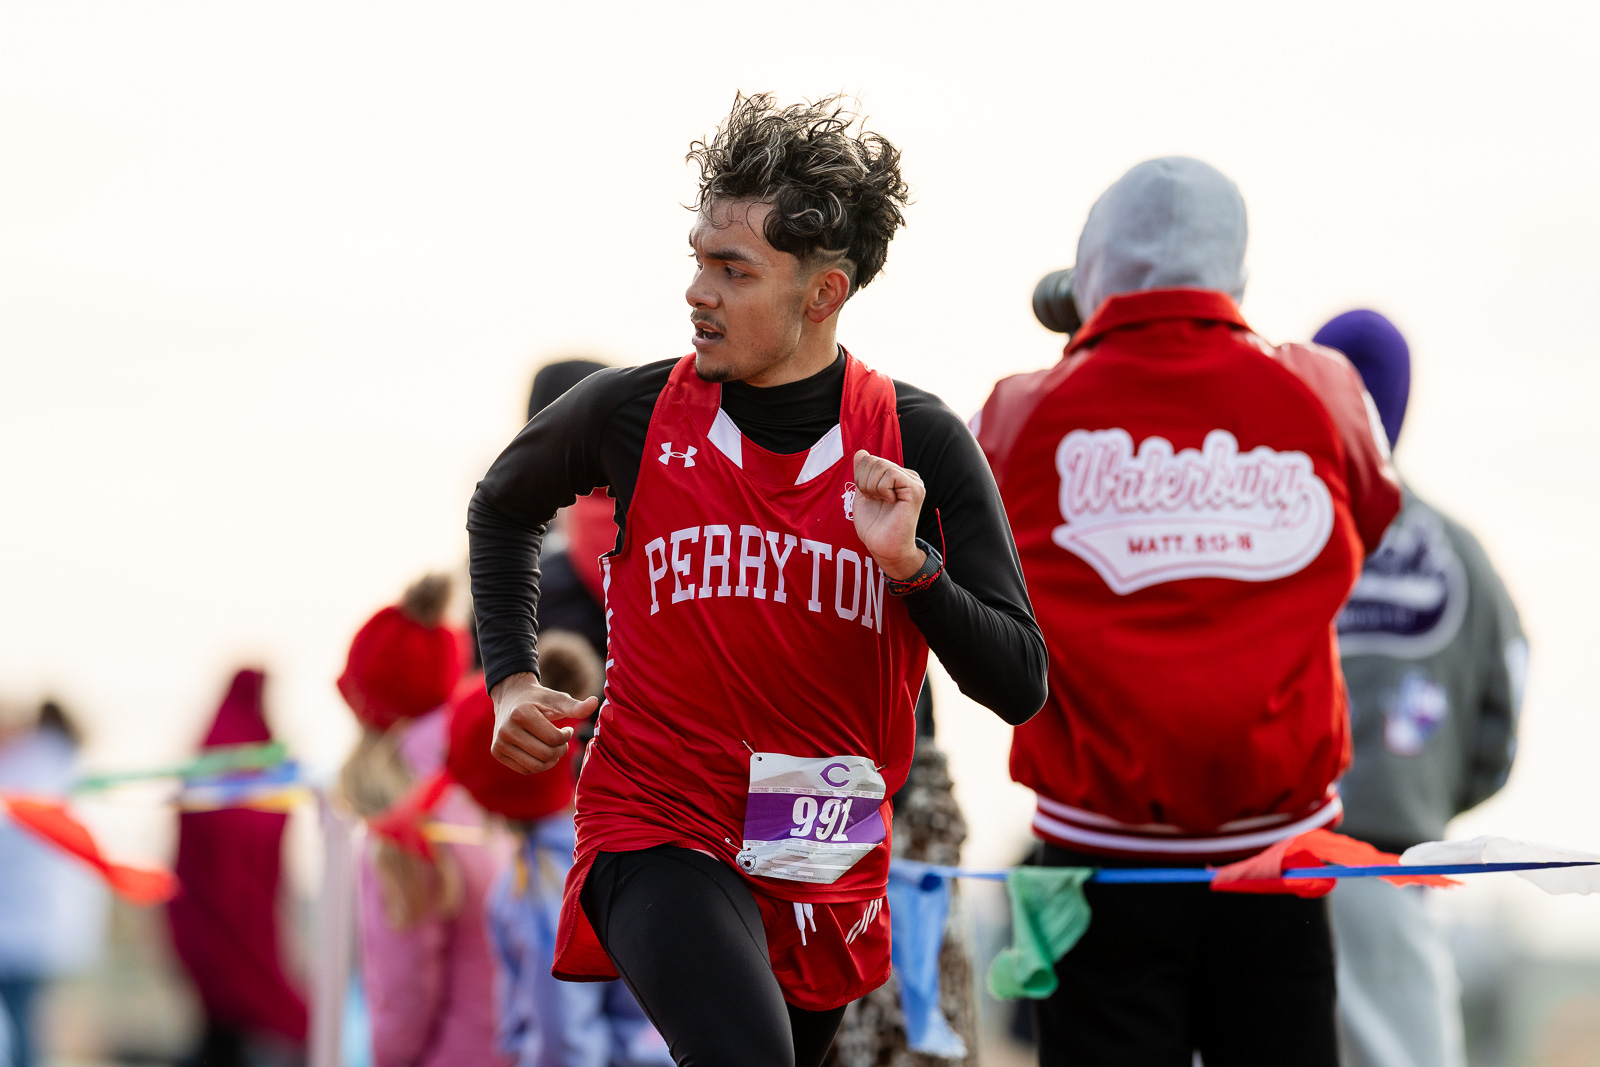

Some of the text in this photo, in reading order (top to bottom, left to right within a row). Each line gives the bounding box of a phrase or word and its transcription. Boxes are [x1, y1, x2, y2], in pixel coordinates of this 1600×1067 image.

[1066, 438, 1310, 528] Waterbury
[644, 524, 885, 635] PERRYTON
[789, 796, 854, 842] 991
